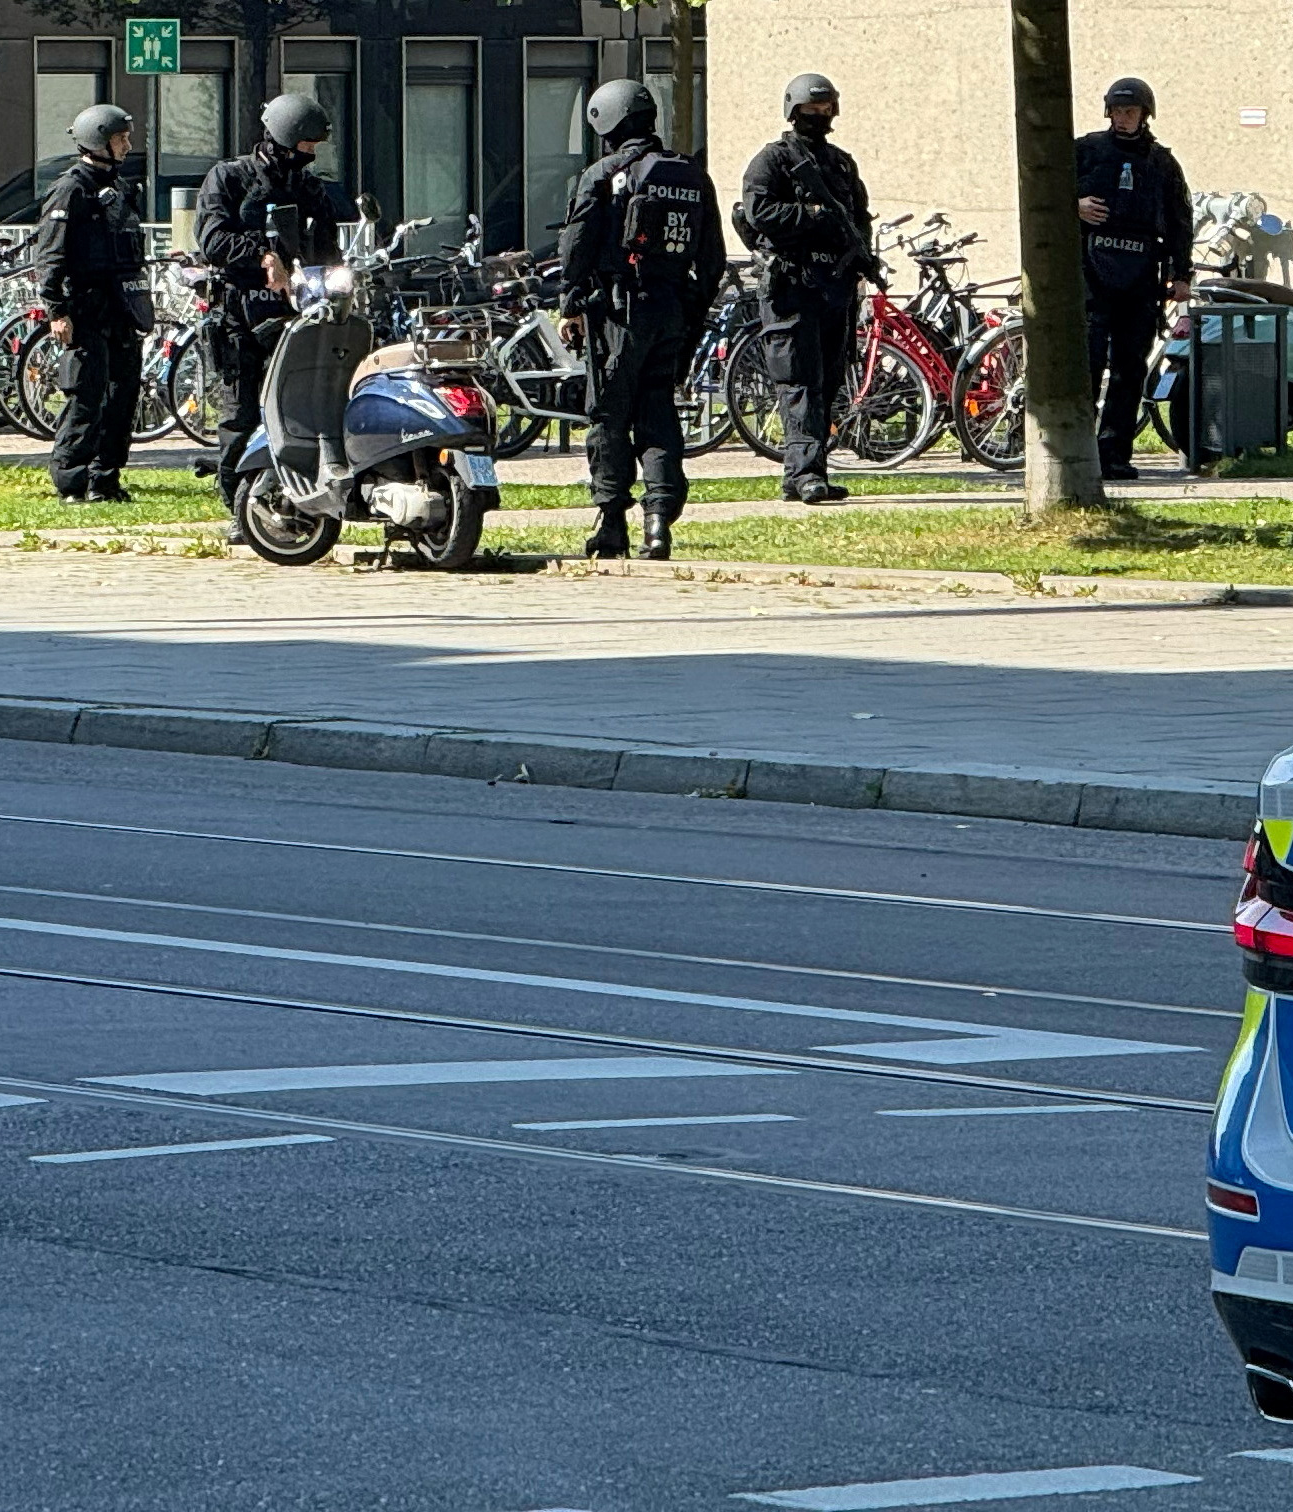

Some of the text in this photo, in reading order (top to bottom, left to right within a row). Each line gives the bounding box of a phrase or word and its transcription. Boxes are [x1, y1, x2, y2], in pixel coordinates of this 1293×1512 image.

[648, 184, 701, 202] POLIZEI
[667, 211, 688, 226] BY
[663, 226, 691, 242] 1421
[1094, 235, 1144, 253] POLIZEI
